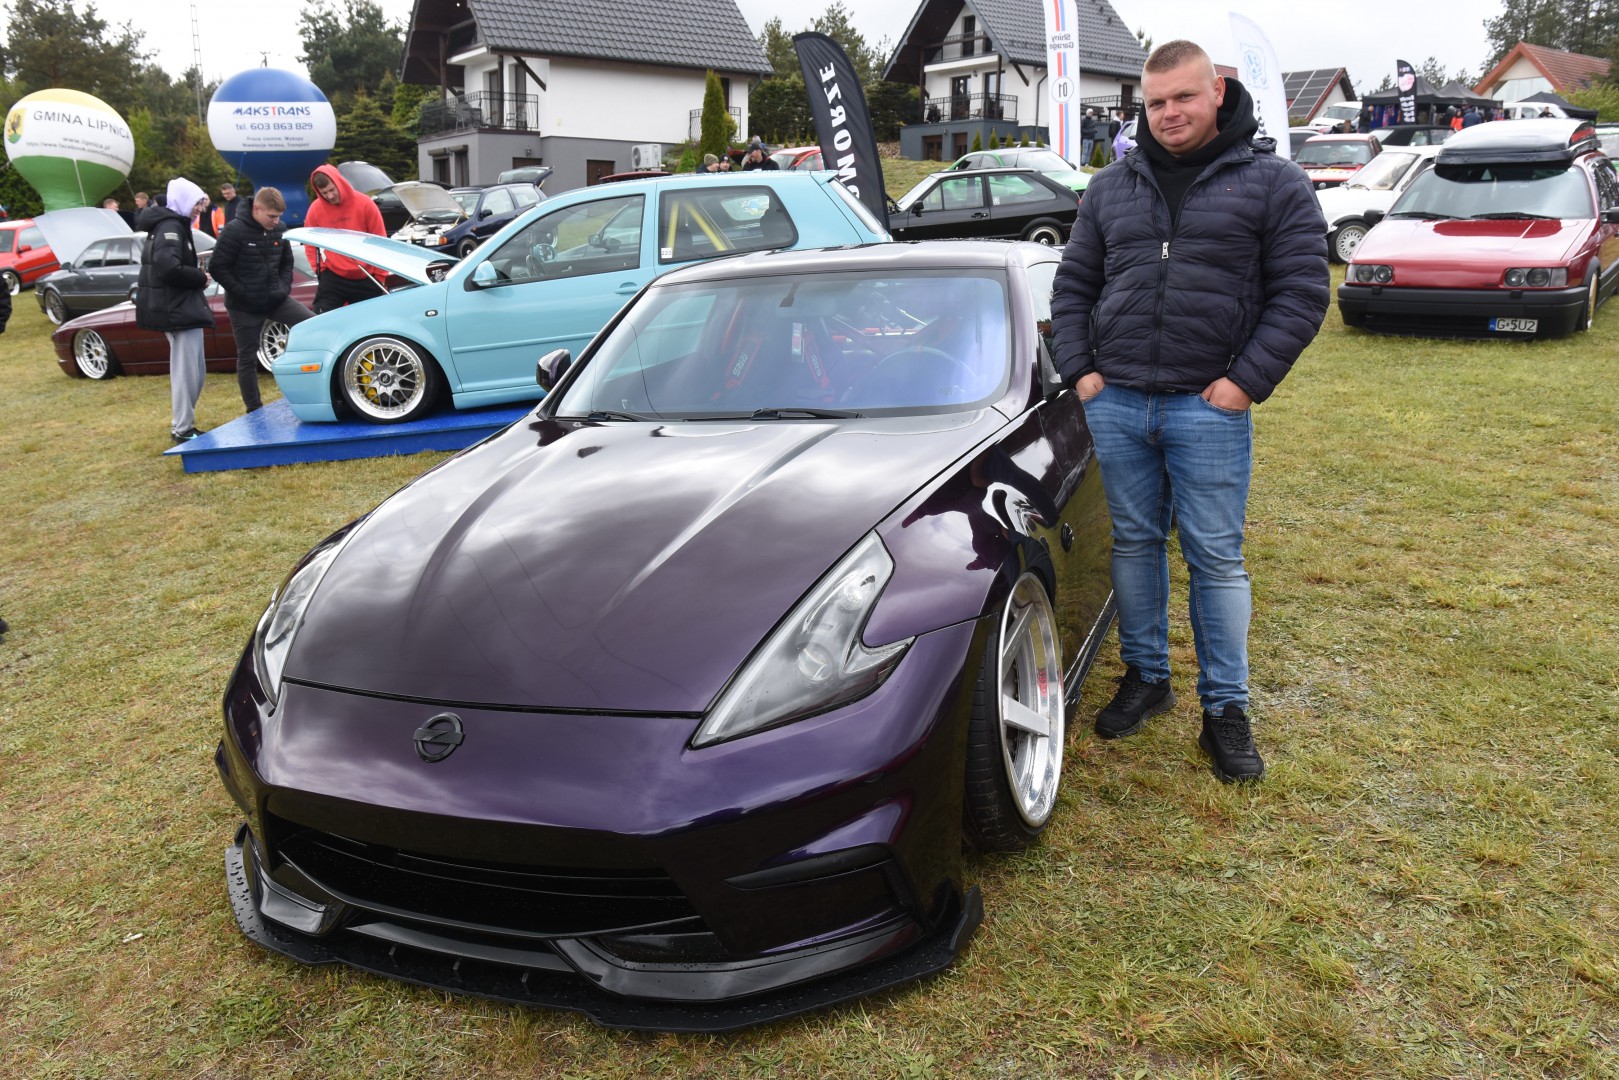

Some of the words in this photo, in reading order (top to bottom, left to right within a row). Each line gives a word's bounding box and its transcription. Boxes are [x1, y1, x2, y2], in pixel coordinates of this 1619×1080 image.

[33, 110, 83, 126] GMINA
[87, 117, 131, 140] LIPNICA
[250, 122, 271, 130] 603
[273, 122, 293, 130] 863
[296, 122, 313, 130] 829
